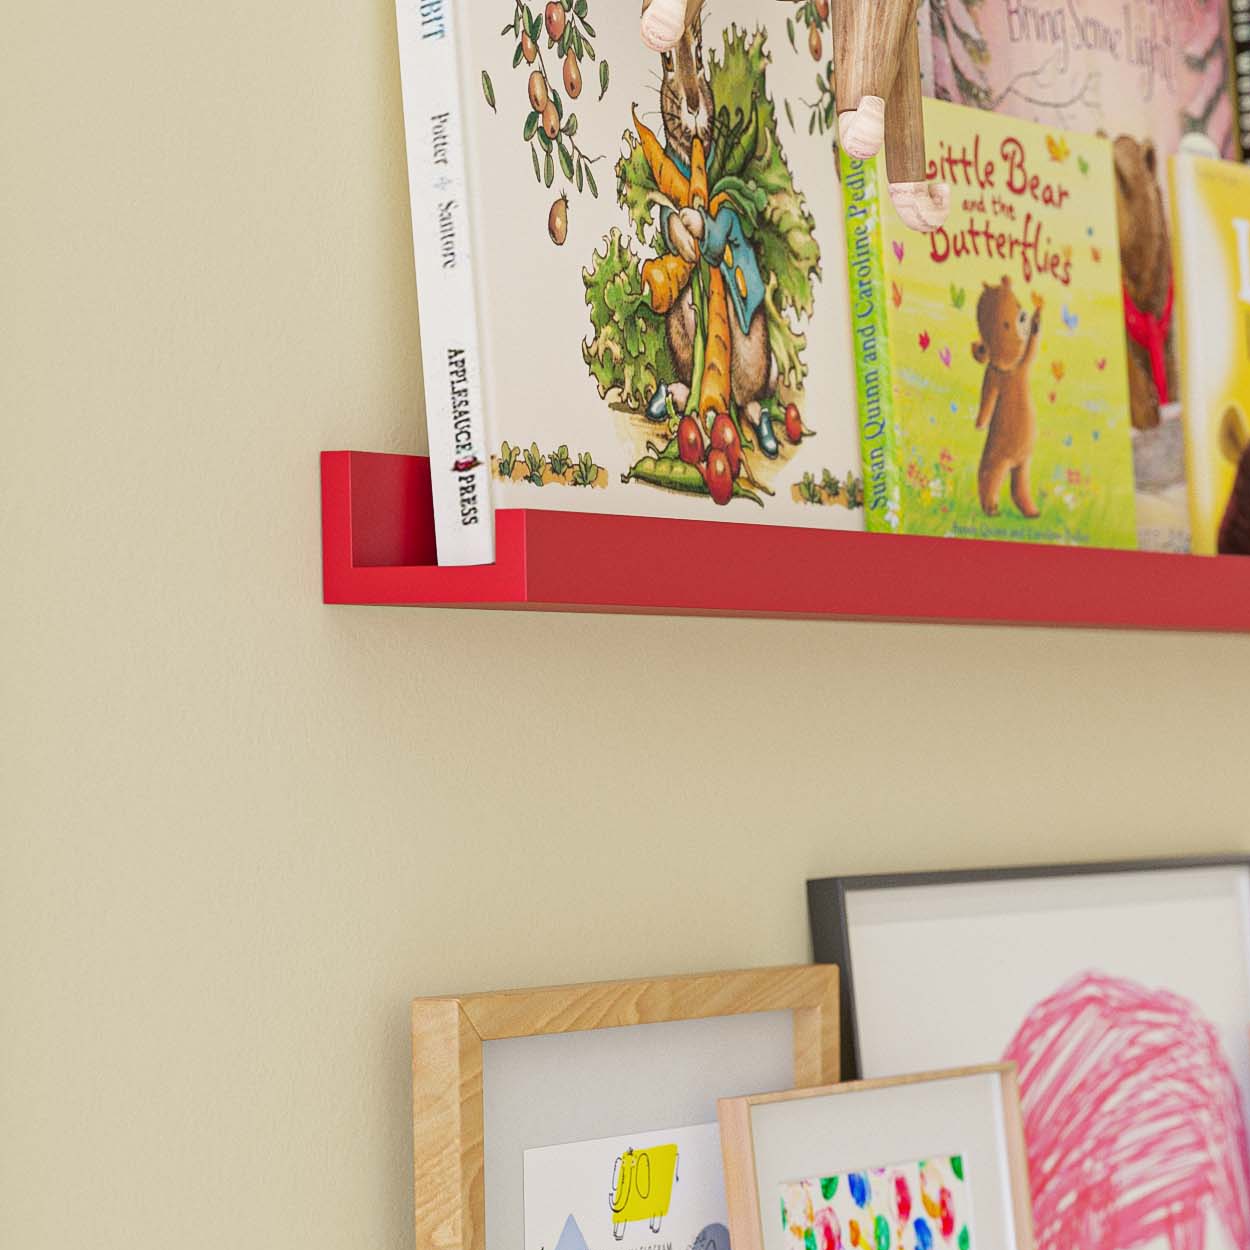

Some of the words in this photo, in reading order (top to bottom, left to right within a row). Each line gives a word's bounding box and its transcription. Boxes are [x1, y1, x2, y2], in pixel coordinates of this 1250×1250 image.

[431, 112, 450, 165] Potter
[846, 158, 868, 217] Pedle
[926, 134, 995, 189] ittle
[1000, 137, 1069, 208] Bear
[962, 195, 986, 213] and
[991, 195, 1016, 221] the
[853, 225, 875, 319] Caroline
[857, 325, 877, 363] and
[447, 348, 473, 455] APPLESAUCE
[864, 370, 886, 440] Quinn
[458, 474, 479, 526] PRESS
[870, 447, 888, 511] Susan
